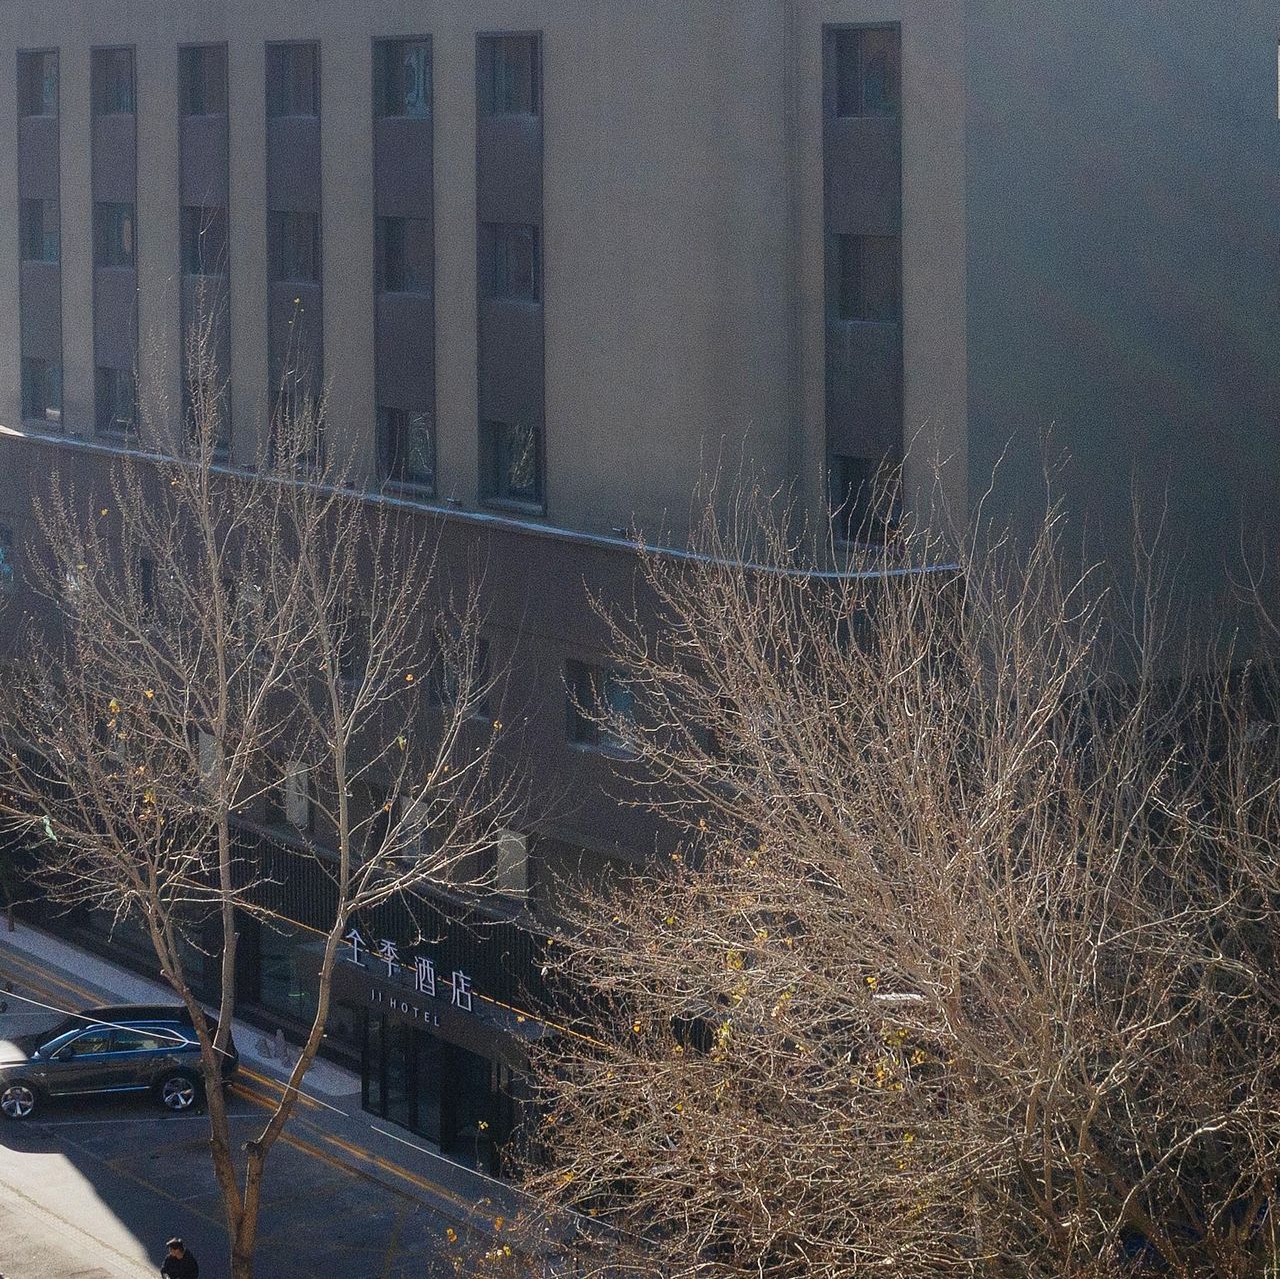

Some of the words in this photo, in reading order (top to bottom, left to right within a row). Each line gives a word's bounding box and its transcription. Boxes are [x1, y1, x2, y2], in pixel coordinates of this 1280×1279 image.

[346, 928, 472, 1012] 全季酒店
[371, 988, 382, 1002] JI
[390, 997, 440, 1027] HOTEL
